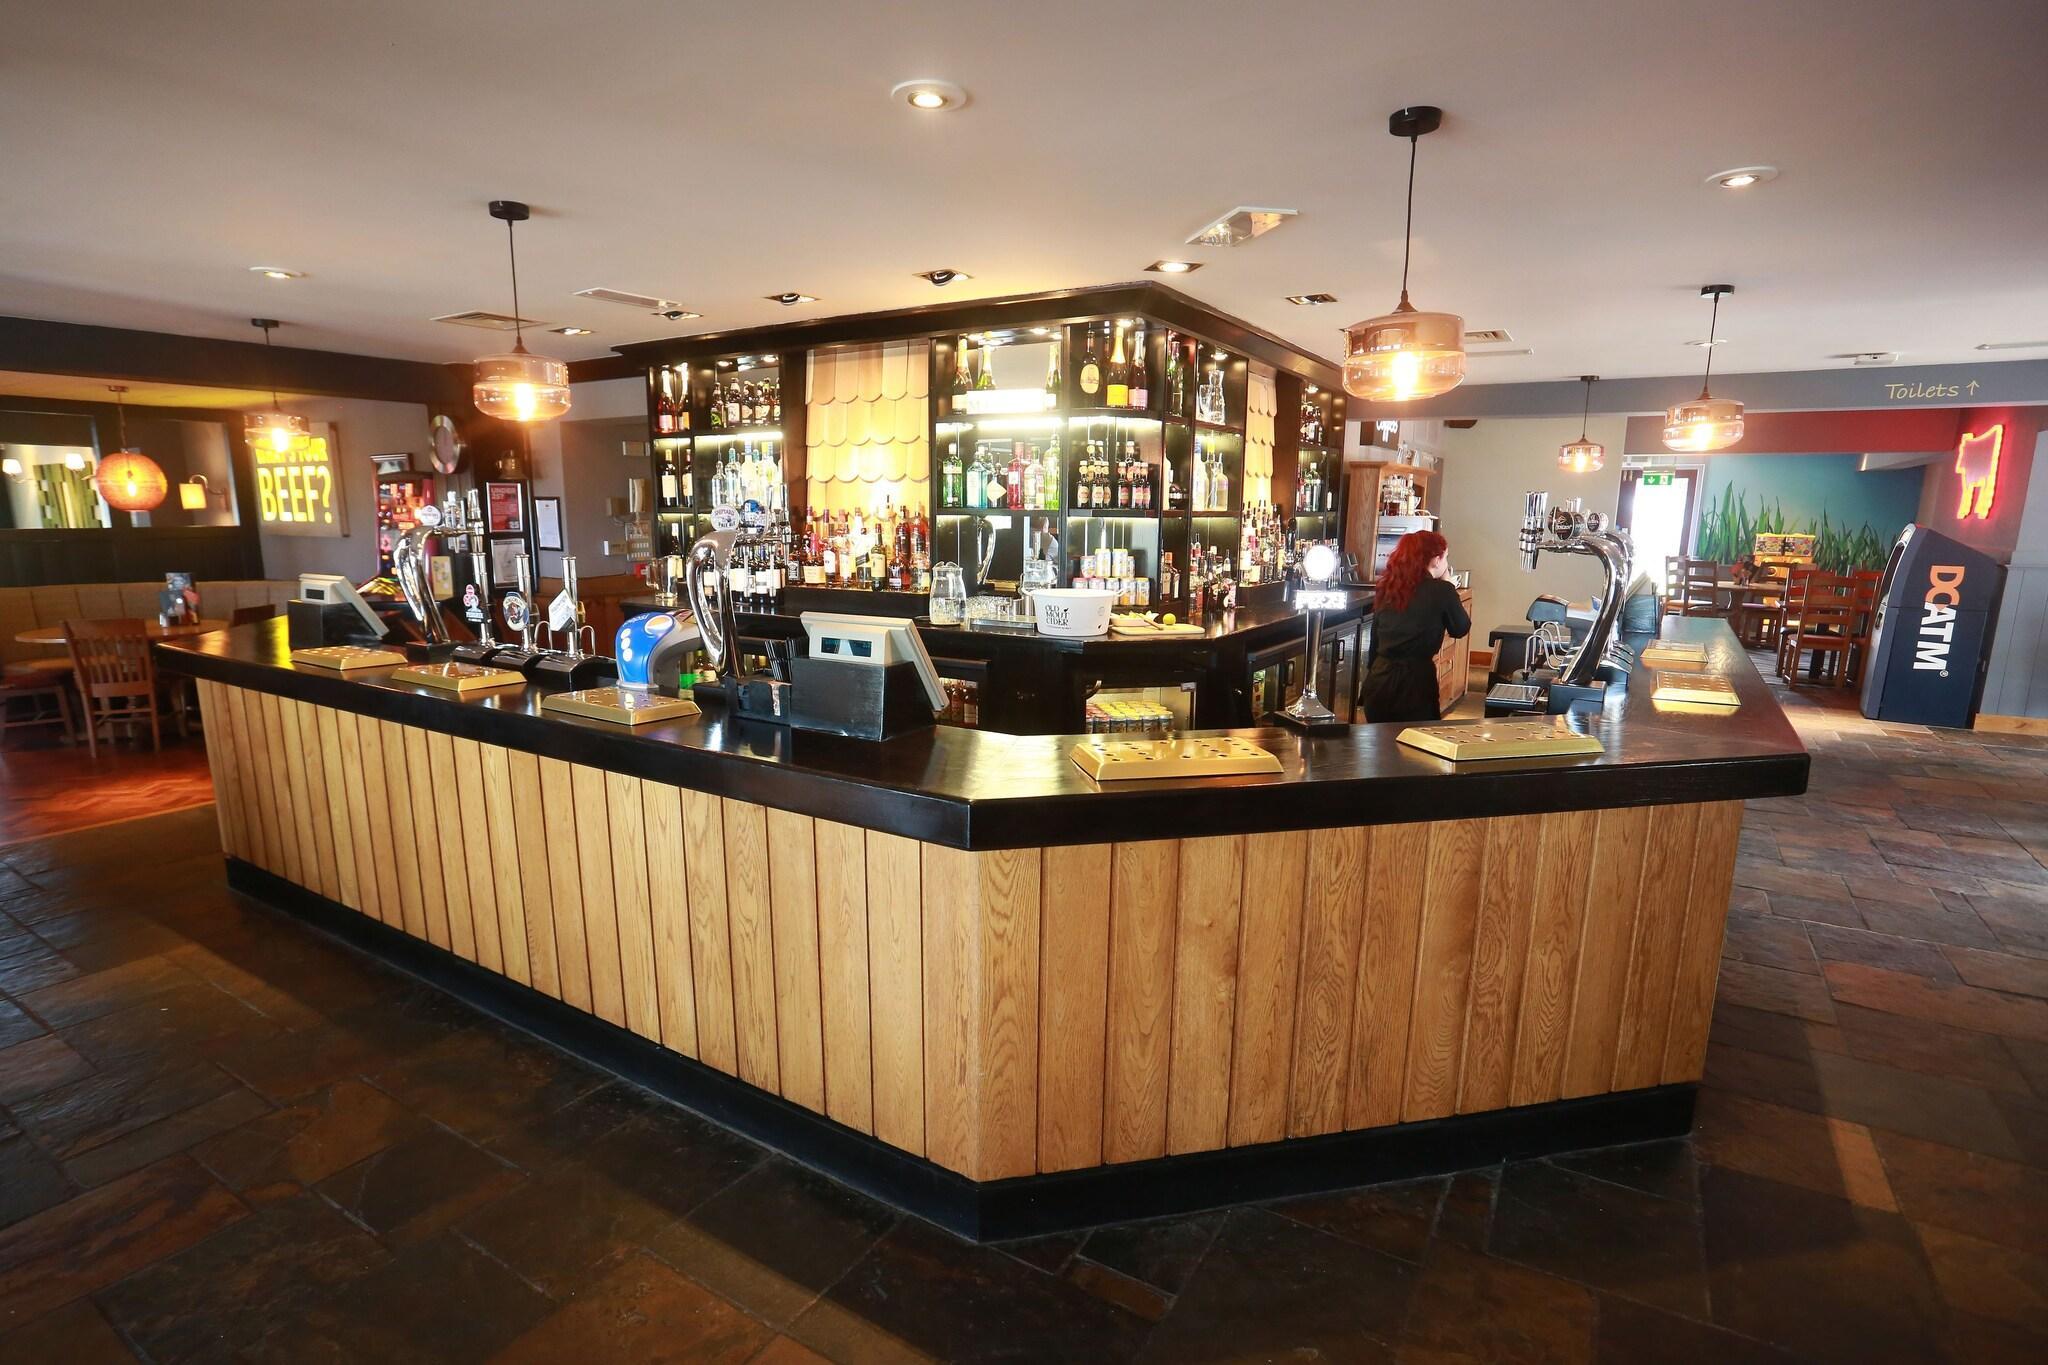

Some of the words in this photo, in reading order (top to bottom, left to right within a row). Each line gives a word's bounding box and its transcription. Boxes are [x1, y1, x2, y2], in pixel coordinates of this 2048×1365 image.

[1884, 382, 1960, 400] Toilets
[256, 465, 332, 524] BEEF?
[1045, 604, 1060, 612] OLD
[1046, 617, 1069, 626] CIDER
